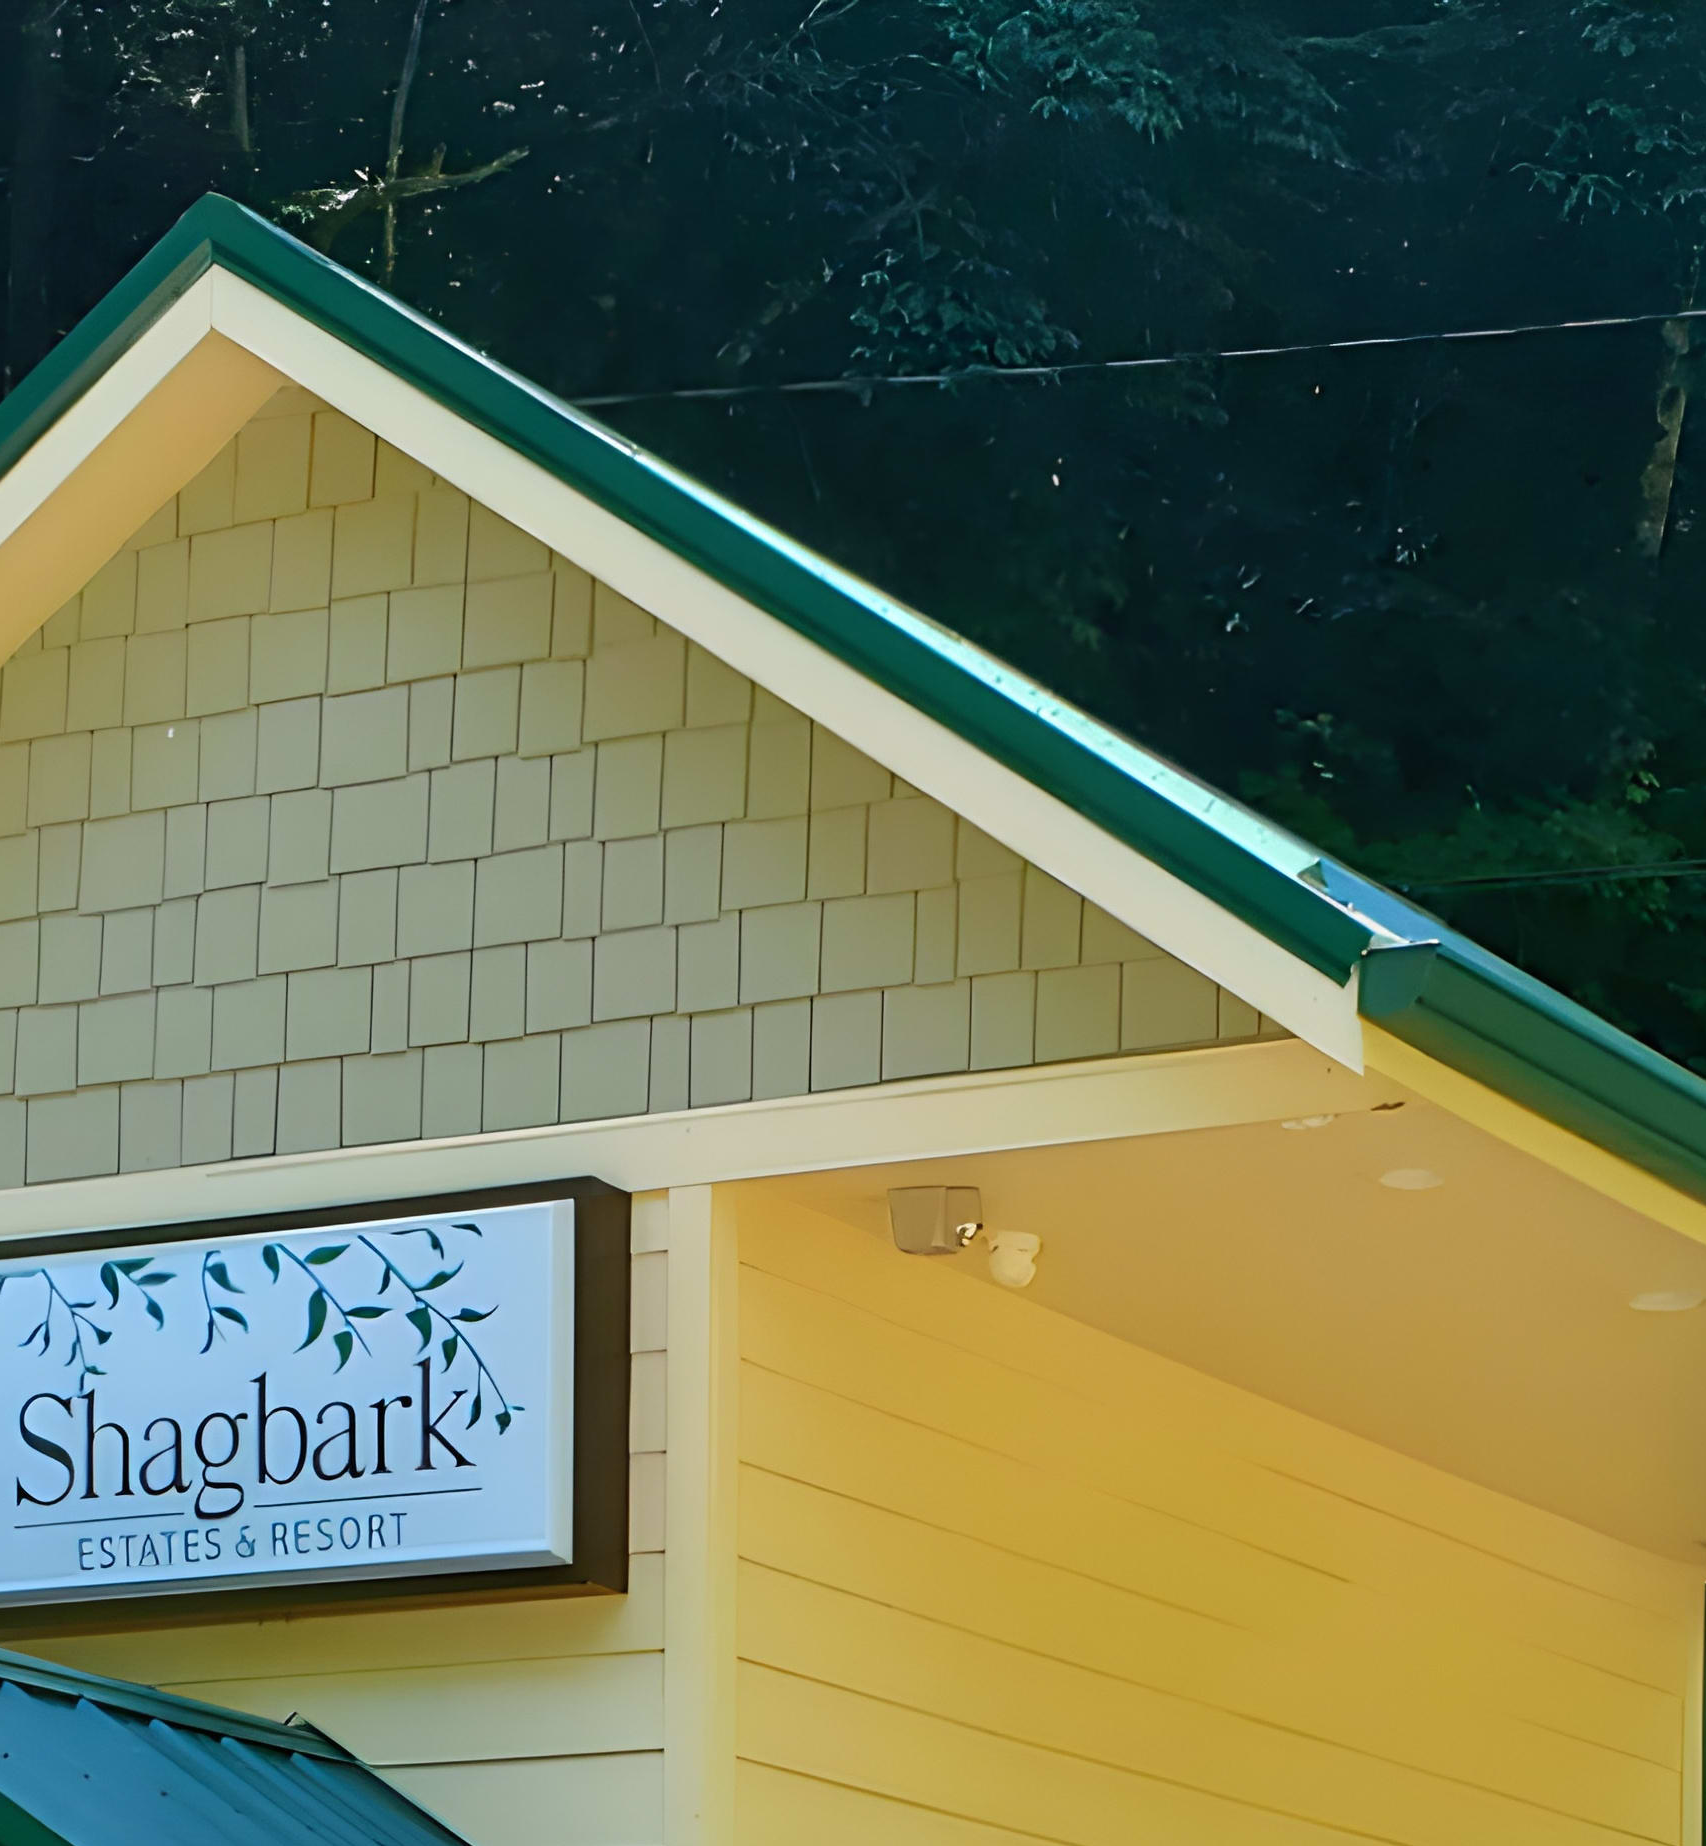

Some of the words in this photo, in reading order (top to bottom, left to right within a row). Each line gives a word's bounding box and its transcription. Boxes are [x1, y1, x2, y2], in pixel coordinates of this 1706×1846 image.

[15, 1356, 477, 1520] Shagbark
[77, 1526, 222, 1572] ESTATES
[234, 1524, 257, 1559] &
[271, 1511, 409, 1557] RESORT
